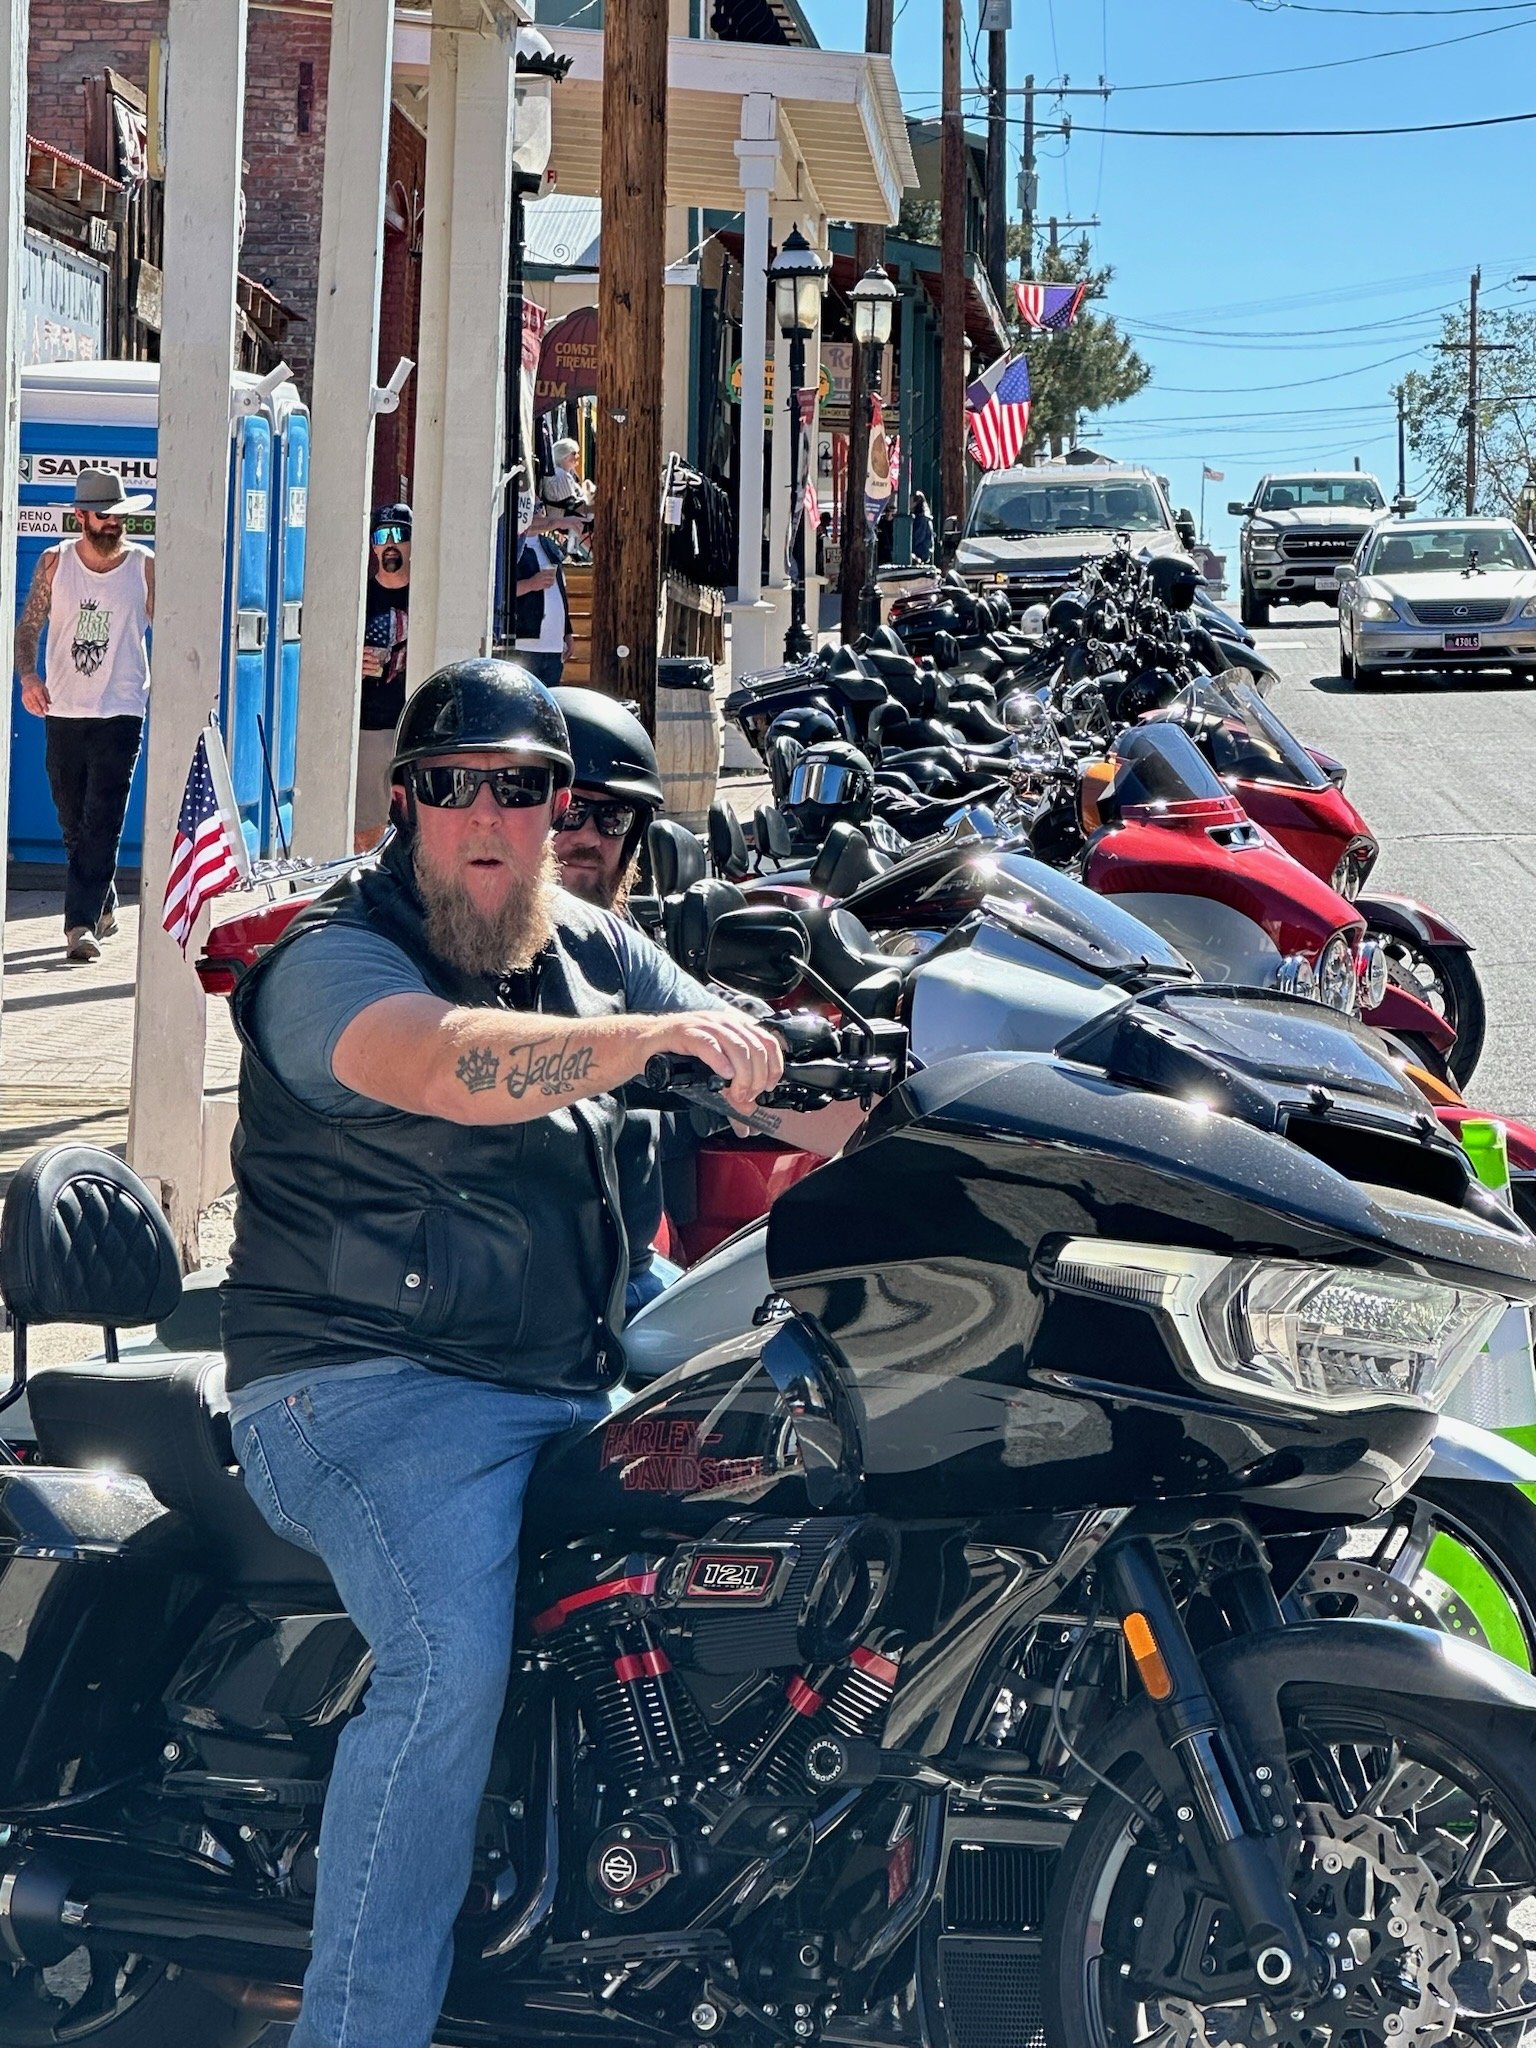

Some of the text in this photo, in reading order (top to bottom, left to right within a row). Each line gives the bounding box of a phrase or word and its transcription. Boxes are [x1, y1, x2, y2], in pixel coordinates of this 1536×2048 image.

[554, 342, 597, 355] COMST
[871, 480, 889, 488] ARMY
[20, 511, 52, 521] RENO
[80, 610, 113, 623] BEST
[501, 1031, 600, 1099] Jaden
[622, 1455, 764, 1491] DAVIDS
[704, 1564, 759, 1585] 121
